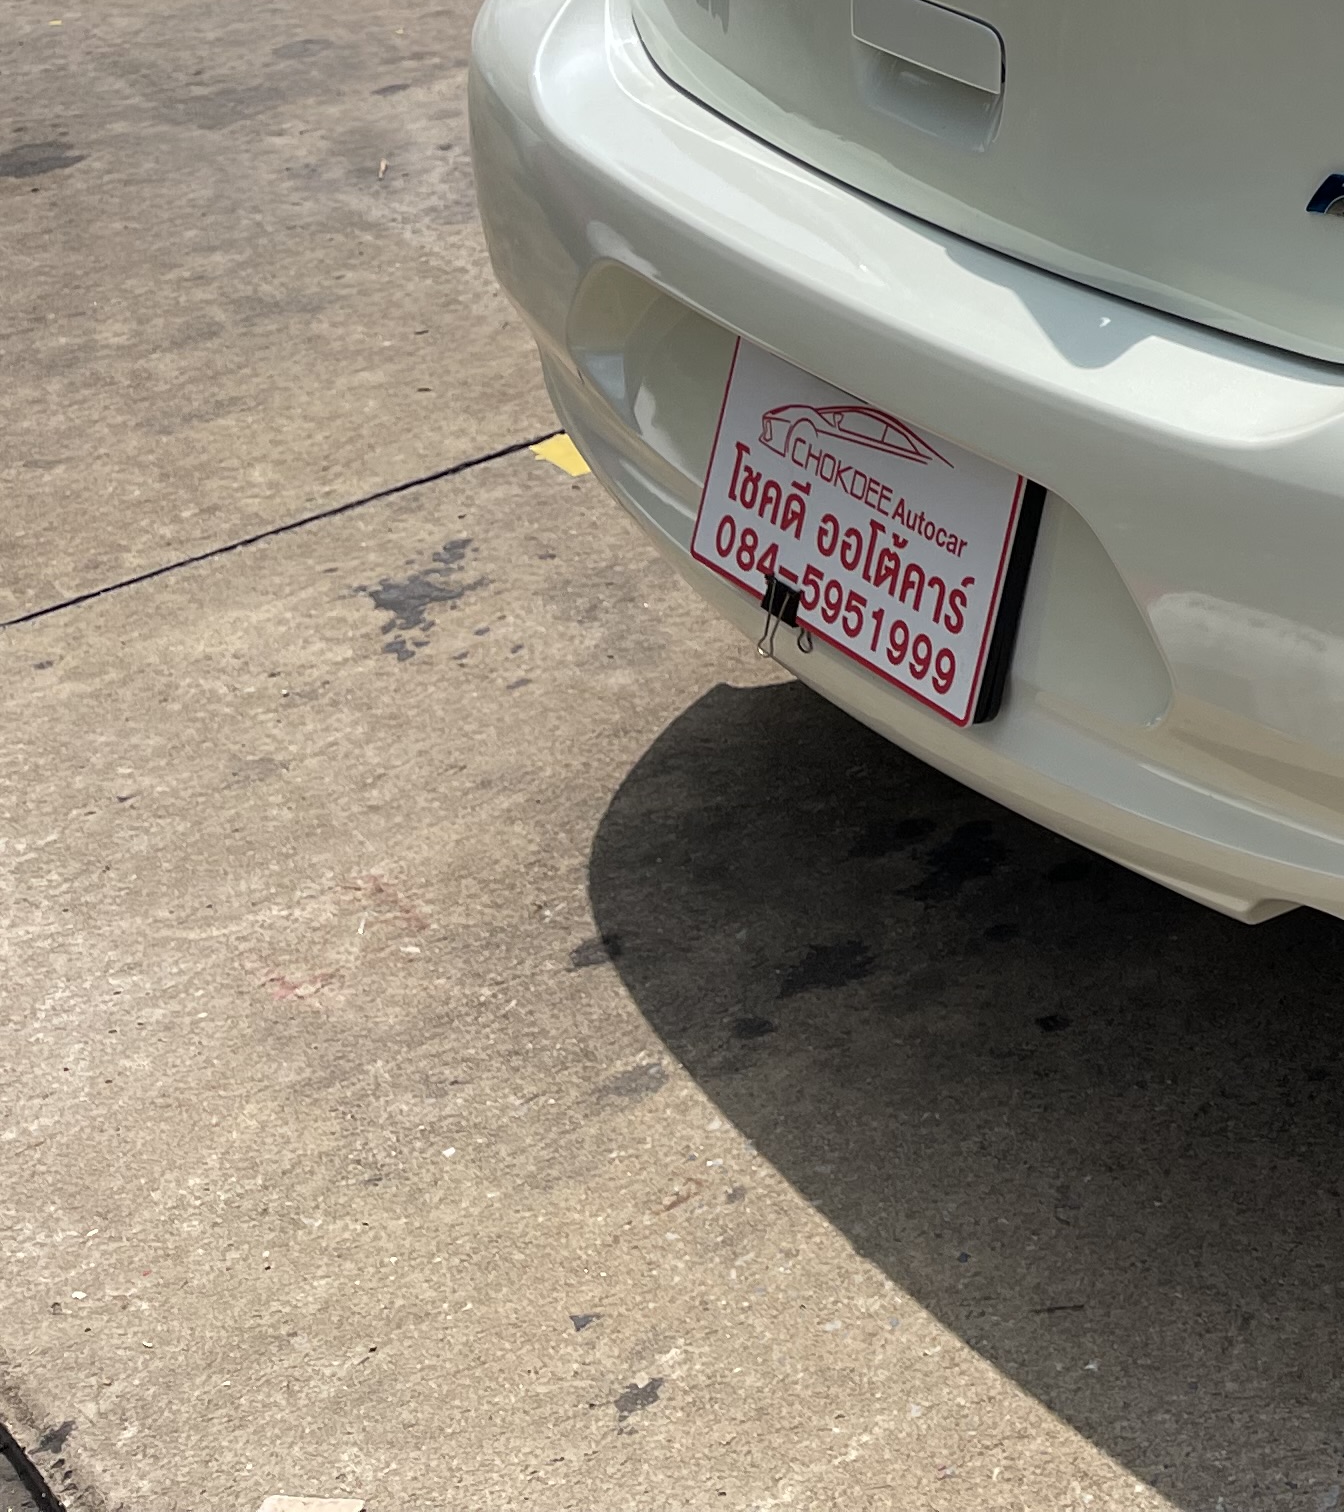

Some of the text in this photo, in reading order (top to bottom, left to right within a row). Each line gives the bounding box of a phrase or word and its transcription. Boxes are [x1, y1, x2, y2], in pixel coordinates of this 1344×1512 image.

[727, 441, 975, 635] โชคดี ออโต้คาร์
[791, 436, 968, 558] CHOKDEE Autocar
[715, 514, 957, 695] 084-5951999
